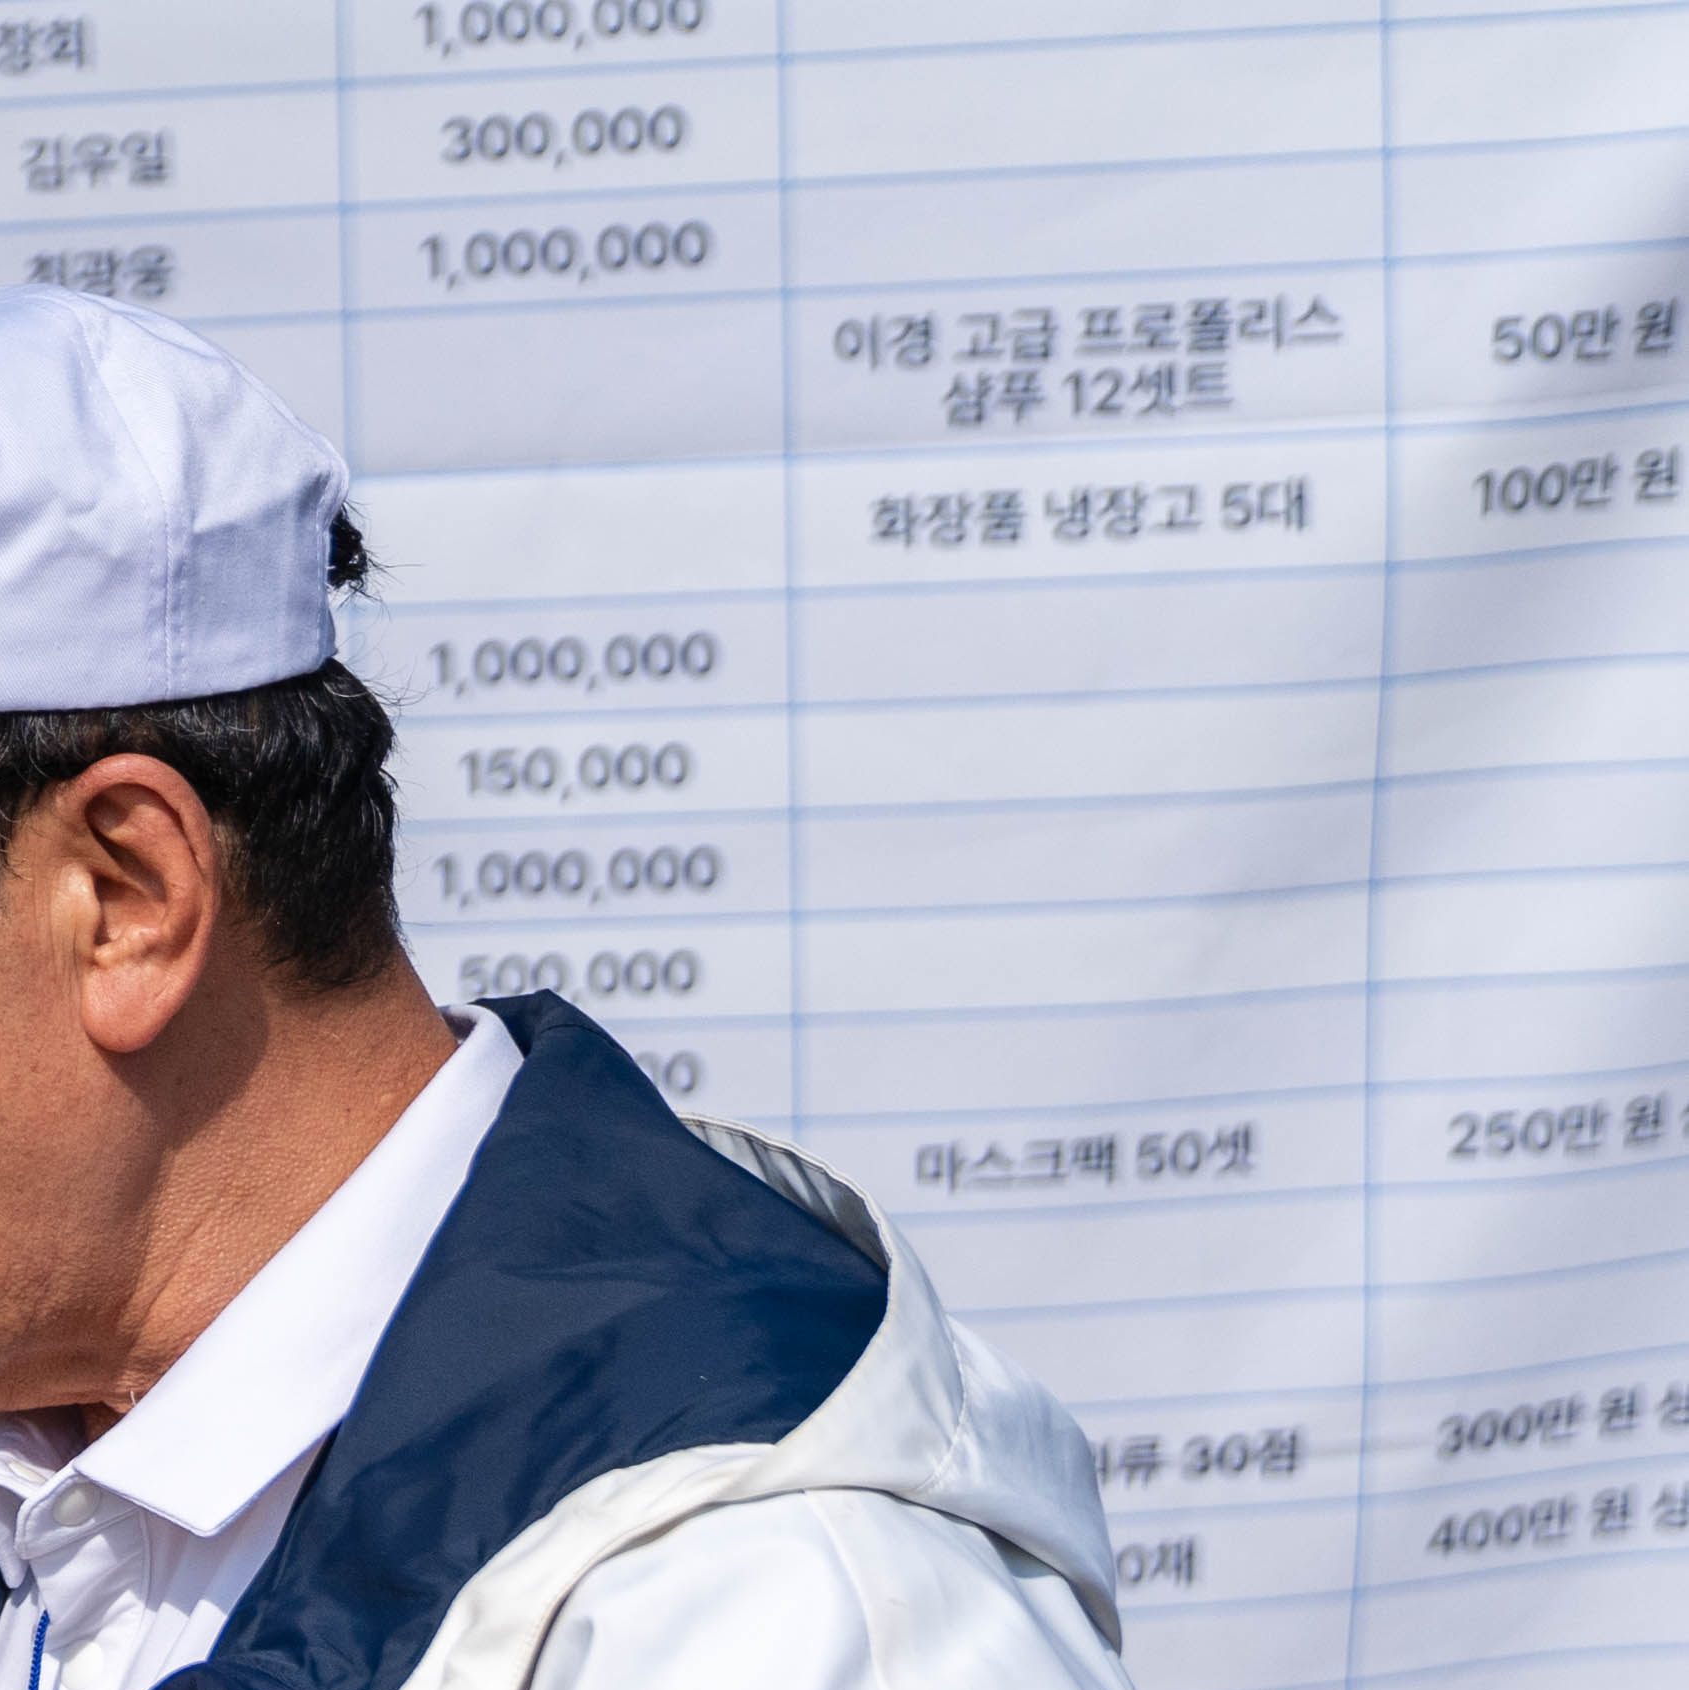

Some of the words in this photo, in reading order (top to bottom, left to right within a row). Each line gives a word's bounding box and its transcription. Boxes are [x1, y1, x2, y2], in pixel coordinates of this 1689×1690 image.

[418, 0, 705, 56] 1,000,000
[441, 104, 687, 167] 300,000
[420, 220, 712, 287] 1,000,000
[833, 311, 936, 370] 이경
[953, 306, 1059, 362] 고급
[1074, 293, 1344, 356] 프로폴리스
[1493, 305, 1620, 364] 50만
[1634, 297, 1679, 353] 원
[942, 367, 1046, 428] 샴푸
[1062, 360, 1234, 418] 12셋트
[871, 489, 1025, 549] 화장품
[1044, 482, 1203, 543] 냉장고
[1222, 475, 1311, 533] 5대
[1473, 453, 1620, 518] 100만
[1634, 447, 1679, 503] 원
[429, 629, 719, 696] 1,000,000
[458, 742, 693, 804] 150,000
[433, 844, 721, 908] 1,000,000
[459, 948, 703, 1000] 500,000
[914, 1132, 1118, 1194] 마스크팩
[1136, 1121, 1255, 1178] 50셋
[1448, 1099, 1611, 1161] 250만
[1624, 1090, 1668, 1147] 원
[1437, 1392, 1590, 1460] 300만
[1424, 1493, 1578, 1559] 400만
